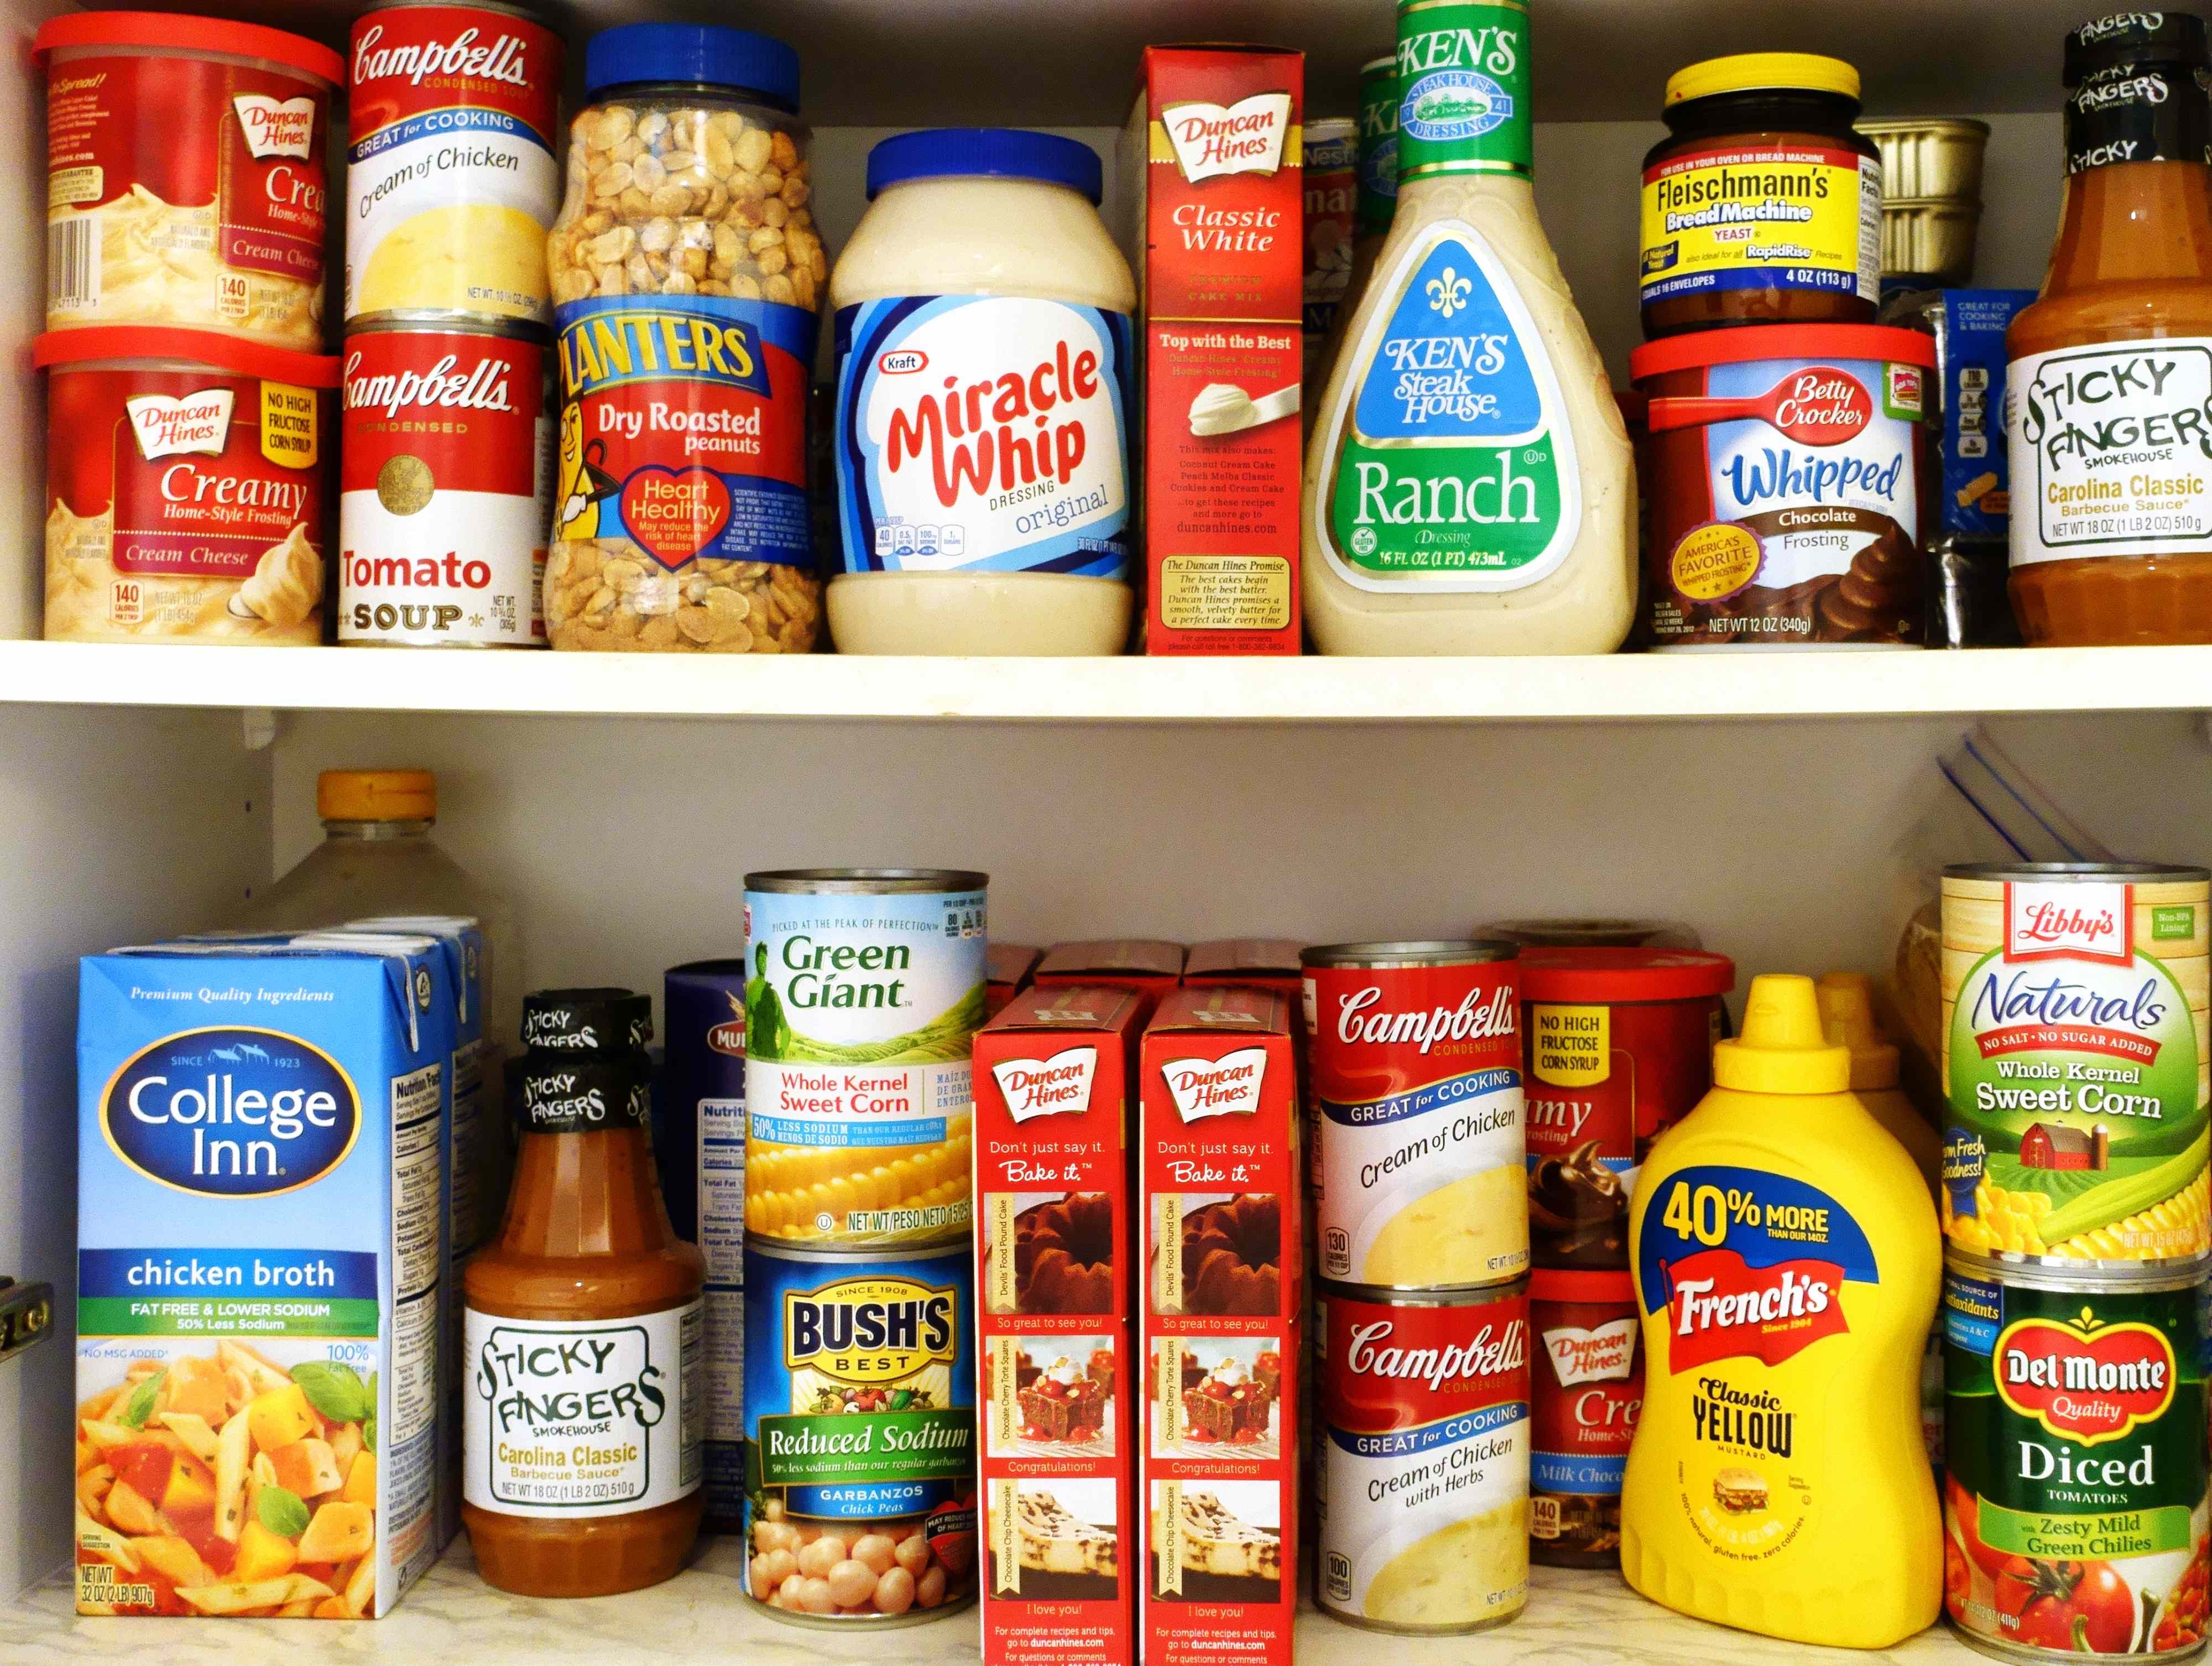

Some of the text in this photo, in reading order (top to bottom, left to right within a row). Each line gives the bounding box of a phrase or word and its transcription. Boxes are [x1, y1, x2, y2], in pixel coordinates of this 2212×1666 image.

[354, 25, 528, 86] Campbell's
[1397, 27, 1517, 77] KEN'S
[243, 107, 307, 126] Duncan
[1175, 111, 1274, 143] Duncan
[1414, 119, 1489, 137] DRESSING
[258, 125, 305, 146] Hines
[1195, 137, 1267, 165] Hines
[1658, 168, 1828, 212] Fleischmann's
[1173, 205, 1281, 227] Classic
[1181, 229, 1274, 252] White
[1715, 229, 1751, 240] YEAST
[1747, 244, 1811, 259] RapidRise
[1160, 334, 1291, 351] Top with the Best
[1385, 334, 1508, 376] KEN'S
[888, 357, 916, 368] Kraft
[343, 351, 513, 418] Campbell's
[1394, 372, 1473, 399] Steak
[1793, 376, 1855, 404] Betty
[887, 340, 1097, 473] Miracle
[1775, 399, 1864, 426] Crocker
[2023, 358, 2176, 445] STICKY
[136, 404, 220, 429] Duncan
[599, 402, 760, 439] Dry Roasted
[154, 425, 214, 446] Hines
[685, 436, 760, 455] peanuts
[934, 415, 1085, 507] Whip
[645, 480, 708, 499] Heart
[1353, 450, 1540, 524] Ranch
[1721, 448, 1902, 506] Whipped
[161, 464, 307, 519] Creamy
[990, 481, 1054, 511] DRESSING
[164, 505, 292, 529] Home-Style Frosting
[632, 500, 720, 525] Healthy
[1016, 485, 1109, 533] original
[1778, 509, 1856, 525] Chocolate
[1415, 529, 1470, 547] Dressing
[1685, 536, 1740, 558] AMERICA'S
[1784, 532, 1849, 551] Frosting
[126, 546, 248, 565] Cream Cheese
[1168, 560, 1284, 571] The Duncan Hines Promise
[1679, 546, 1752, 575] FAVORITE
[343, 550, 491, 589] Tomato
[115, 585, 139, 602] 140
[354, 603, 462, 630] SOUP
[2018, 902, 2113, 941] Libby's
[782, 935, 910, 970] Green
[130, 987, 335, 1004] Premium Quality Ingredients
[787, 973, 904, 1009] Giant
[1972, 971, 2166, 1030] Naturals
[1339, 986, 1514, 1053] Campbell's
[1541, 1016, 1599, 1030] NO HIGH
[1541, 1036, 1598, 1050] FRUCTOSE
[1984, 1032, 2152, 1056] NO SALT NO SUGAR ADDED
[171, 1056, 300, 1068] SINCE 1923
[1542, 1055, 1599, 1070] CORN SYRUP
[1996, 1061, 2139, 1084] Whole Kernel
[782, 1073, 907, 1091] Whole Kernel
[1003, 1063, 1083, 1092] Duncan
[1171, 1063, 1253, 1091] Duncan
[128, 1074, 336, 1139] College
[781, 1092, 909, 1112] Sweet Corn
[1020, 1084, 1080, 1110] Hines
[1188, 1085, 1249, 1110] Hines
[1352, 1071, 1510, 1122] GREAT for COOKING
[1976, 1082, 2162, 1118] Sweet Corn
[192, 1128, 278, 1175] Inn
[990, 1141, 1105, 1154] Don't just say it.
[1361, 1107, 1515, 1189] Cream of Chicken
[999, 1160, 1058, 1182] Bake
[1663, 1181, 1829, 1247] 40% MORE
[1328, 1232, 1345, 1250] 130
[127, 1258, 335, 1287] chicken broth
[836, 1287, 874, 1297] SINCE
[1677, 1271, 1829, 1335] French's
[131, 1303, 330, 1316] FAT FREE & LOWER SODIUM
[178, 1319, 284, 1330] 50% Less Sodium
[794, 1297, 950, 1356] BUSH'S
[998, 1317, 1102, 1329] So great to see you!
[836, 1356, 909, 1371] BEST
[1348, 1319, 1524, 1391] Campbell's
[477, 1339, 615, 1401] STICKY
[2007, 1350, 2166, 1391] Del Monte
[498, 1366, 665, 1434] FINGERS
[1699, 1377, 1782, 1412] Classic
[2053, 1396, 2120, 1422] Quality
[533, 1422, 611, 1438] SMOKEHOUSE
[770, 1422, 968, 1456] Reduced Sodium
[1693, 1395, 1792, 1458] YELLOW
[498, 1443, 637, 1466] Carolina Classic
[1718, 1445, 1765, 1460] MUSTARD
[2018, 1441, 2154, 1485] Diced
[1008, 1461, 1095, 1474] Congratulations!
[1368, 1437, 1513, 1502] Cream of Chicken
[821, 1486, 923, 1502] GARBANZOS
[1406, 1468, 1484, 1508] with Herbs
[2047, 1490, 2127, 1504] TOMATOES
[841, 1503, 902, 1514] Chick Peas
[2041, 1516, 2141, 1535] Zesty Mild
[2028, 1537, 2151, 1555] Green Chilies
[1329, 1557, 1347, 1577] 100
[1031, 1637, 1104, 1647] duncanhines.com
